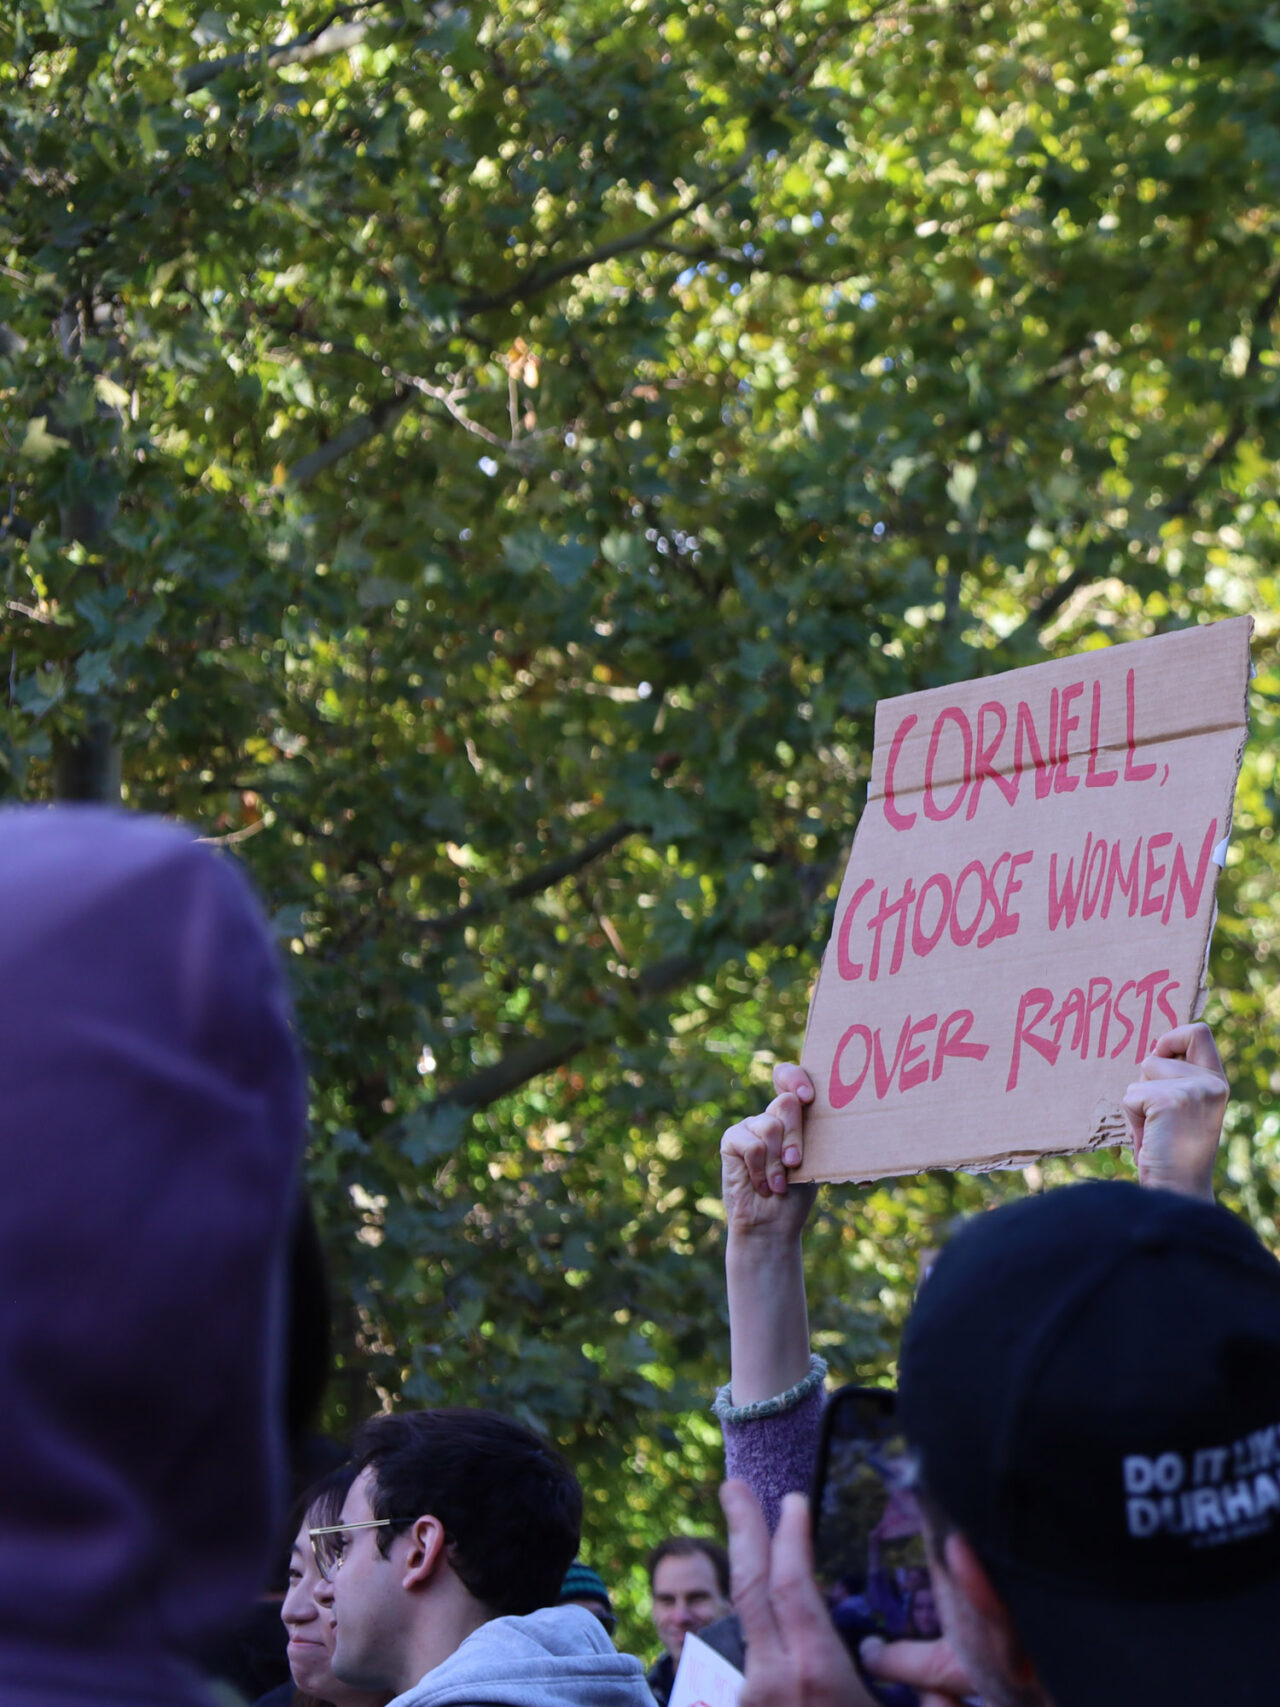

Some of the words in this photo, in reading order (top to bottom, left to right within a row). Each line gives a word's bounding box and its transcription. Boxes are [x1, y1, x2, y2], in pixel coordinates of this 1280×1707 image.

[883, 668, 1170, 831] CORNELL,
[837, 850, 1034, 981] CHOOSE
[1048, 818, 1218, 931] WOMEN
[829, 1009, 990, 1109] OVER
[1006, 969, 1180, 1093] RAPISTS
[1122, 1452, 1185, 1495] DO
[1193, 1446, 1229, 1486] IT
